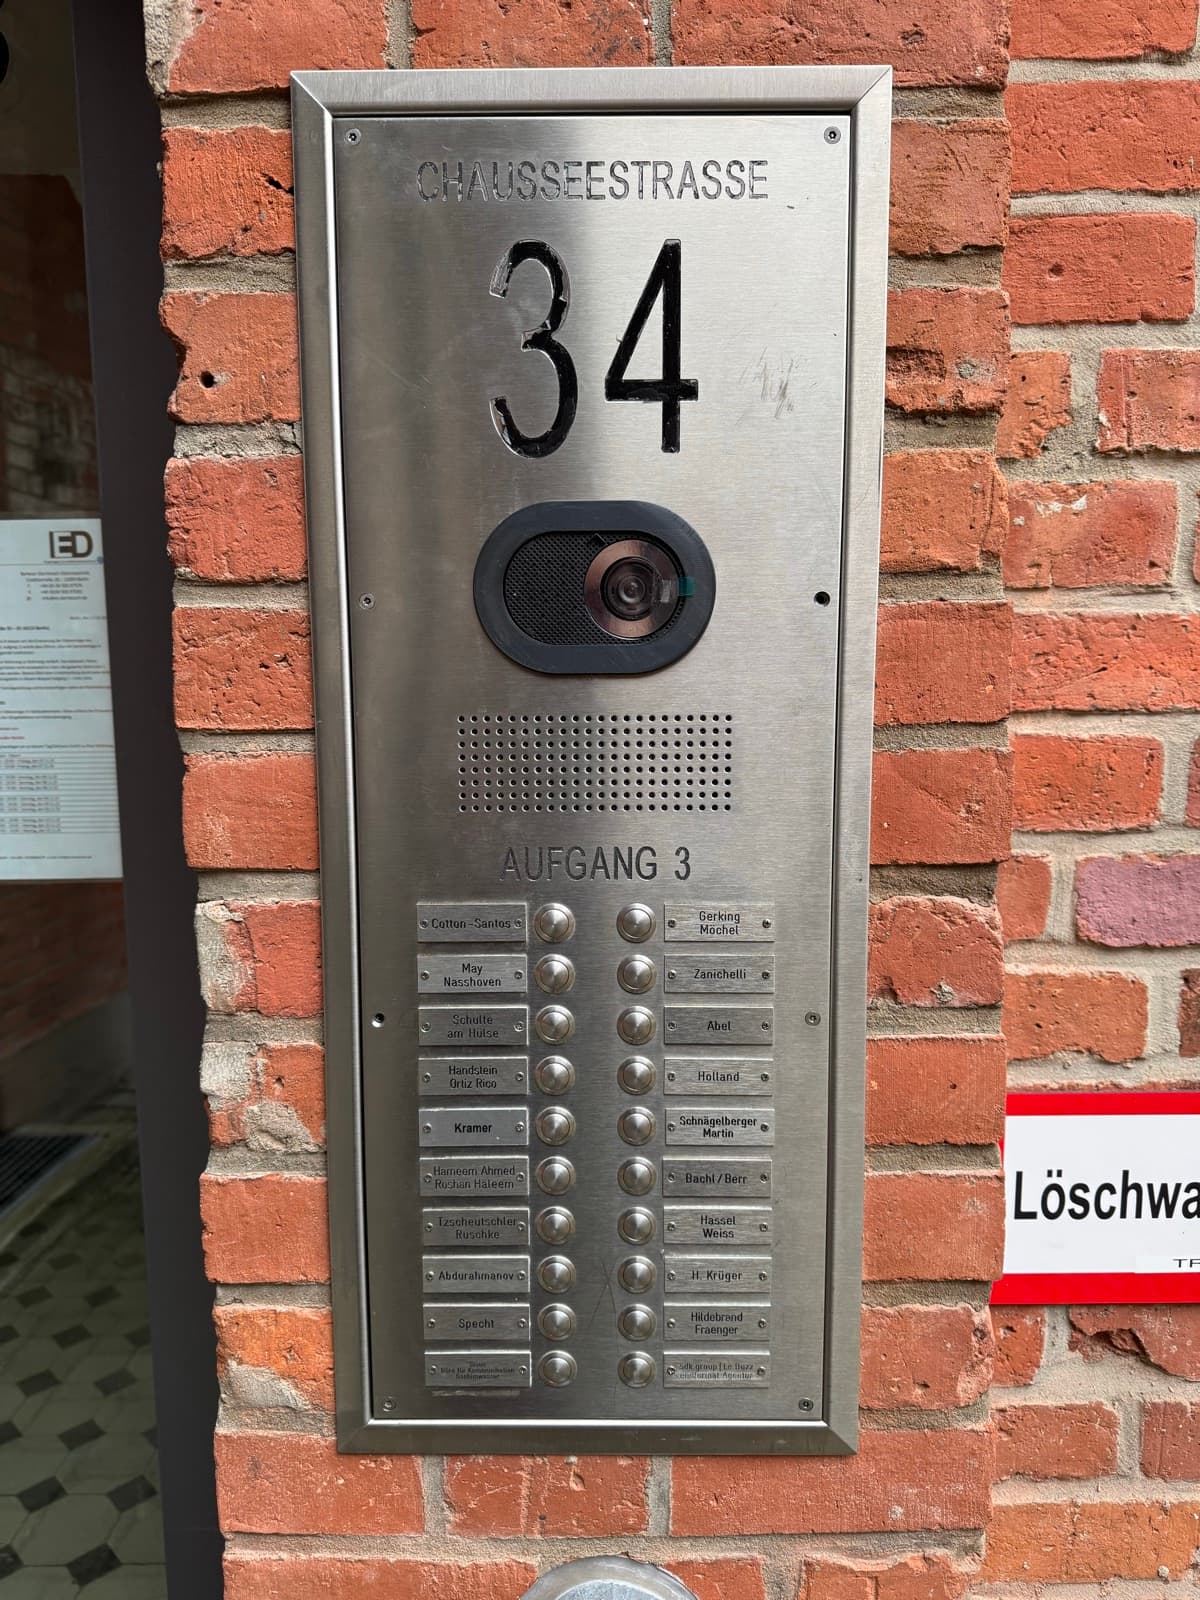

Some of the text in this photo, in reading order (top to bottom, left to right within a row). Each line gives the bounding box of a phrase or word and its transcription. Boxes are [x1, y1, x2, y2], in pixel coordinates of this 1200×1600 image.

[416, 159, 769, 202] CHAUSSEESTRASSE
[489, 238, 699, 458] 34
[500, 845, 692, 881] AUFGANG 3
[431, 917, 512, 929] Cotton-Santos
[699, 911, 741, 924] Gerking
[699, 924, 739, 935] Möchel
[462, 963, 483, 976] May
[693, 968, 747, 980] Zanichelli
[443, 977, 502, 987] Nasshoven
[452, 1015, 494, 1025] Schulte
[707, 1020, 732, 1031] Abel
[447, 1027, 500, 1039] am Hülse
[448, 1065, 498, 1075] Handstein
[698, 1071, 740, 1082] Holland
[450, 1078, 497, 1089] Ortiz Rico
[679, 1115, 758, 1129] Schnägelberger
[454, 1123, 493, 1133] Kramer
[702, 1128, 734, 1138] Martin
[433, 1165, 516, 1176] Hameem Ahmed
[474, 1178, 514, 1189] Haleem
[1013, 1168, 1200, 1220] Löschwa
[438, 1216, 518, 1227] Tzscheutschler
[700, 1215, 736, 1226] Hassel
[455, 1229, 500, 1240] Ruschke
[702, 1228, 735, 1239] Weiss
[438, 1271, 515, 1281] Abdurahmanov
[690, 1270, 743, 1283] H. Krüger
[690, 1311, 743, 1322] Hildebrand
[458, 1318, 495, 1330] Specht
[694, 1324, 738, 1337] Fraenger
